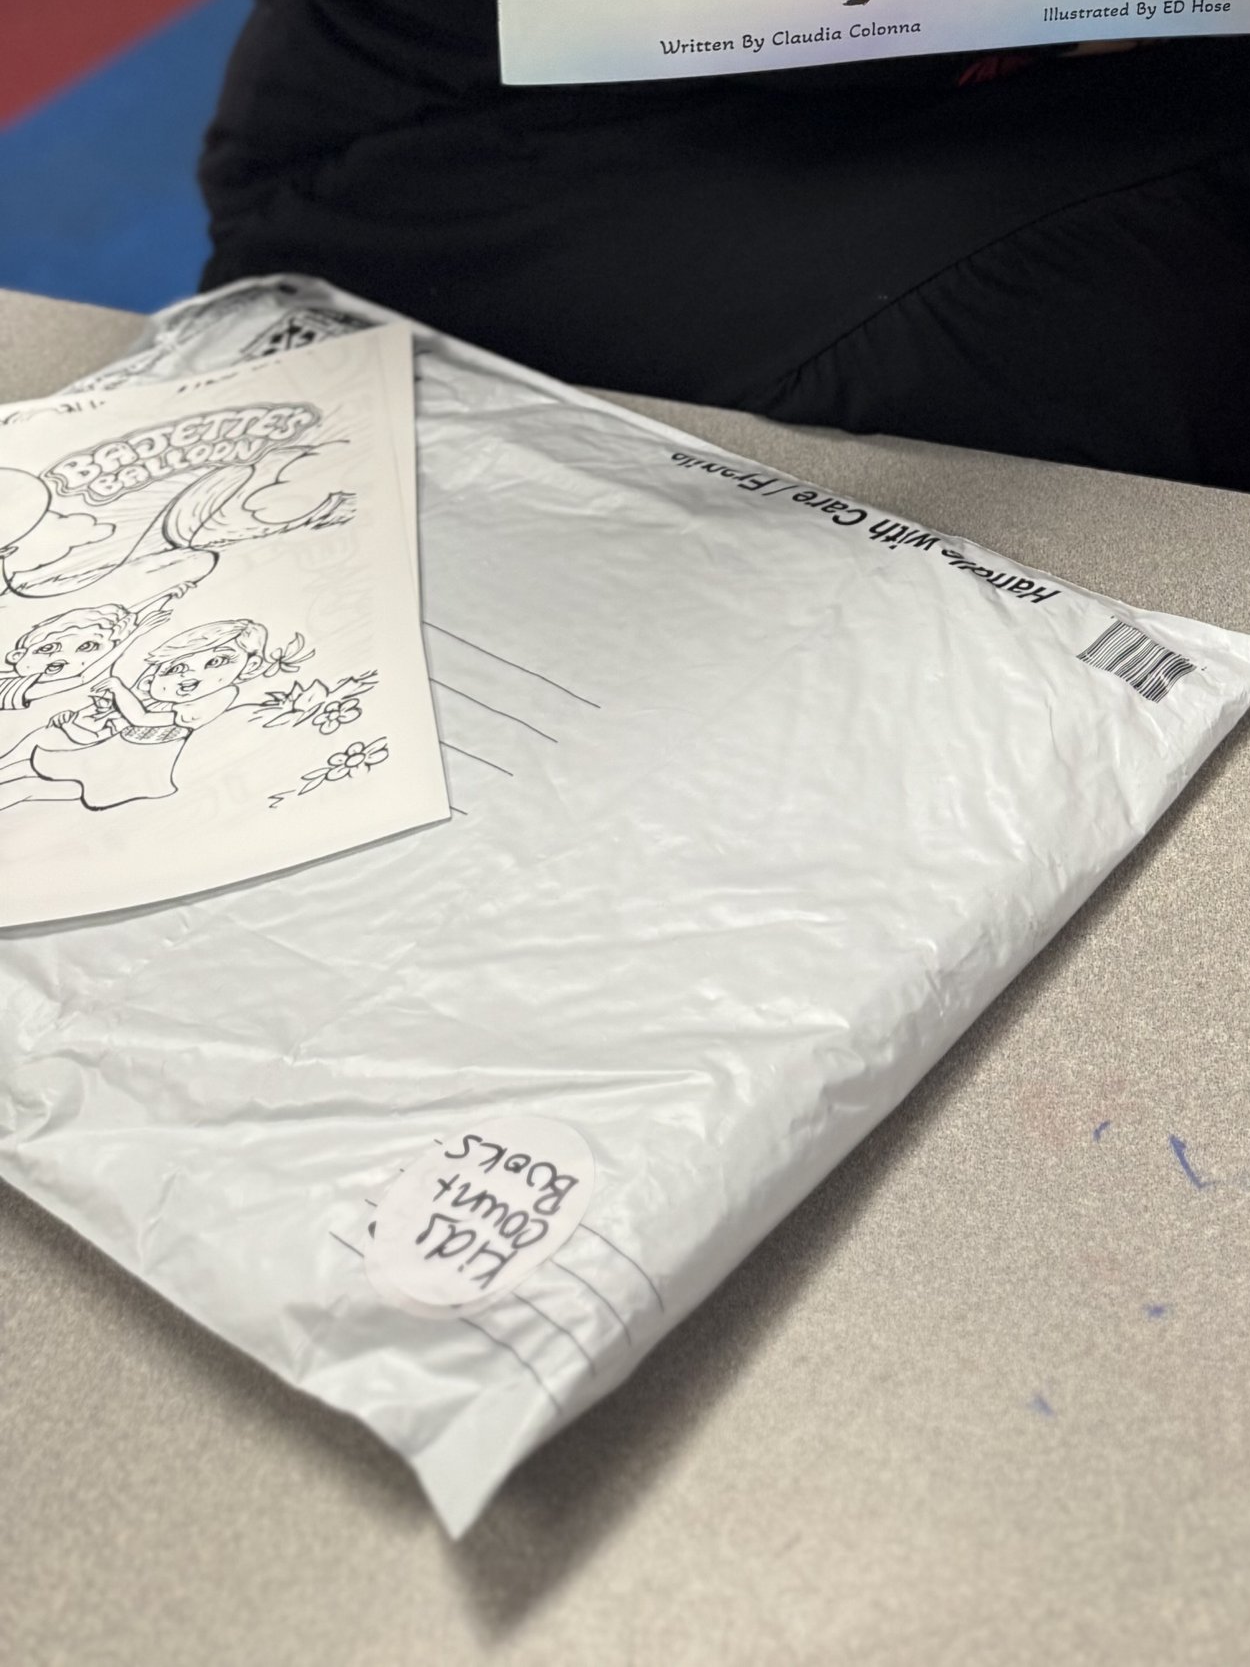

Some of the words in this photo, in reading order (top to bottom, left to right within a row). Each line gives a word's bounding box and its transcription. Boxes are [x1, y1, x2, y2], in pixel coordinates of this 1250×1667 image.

[1043, 2, 1130, 22] Illustrated
[1136, 1, 1157, 20] By
[1163, 0, 1186, 15] ED
[1191, 0, 1231, 14] Hose
[659, 39, 735, 55] Written
[742, 34, 765, 53] By
[772, 26, 842, 46] Claudia
[849, 21, 922, 38] Colonna
[50, 406, 315, 490] BAJETTE'S
[88, 438, 264, 497] BALLOON
[791, 489, 869, 527] Care
[868, 518, 942, 551] with
[443, 1133, 581, 1216] Books
[415, 1212, 520, 1291] Kids
